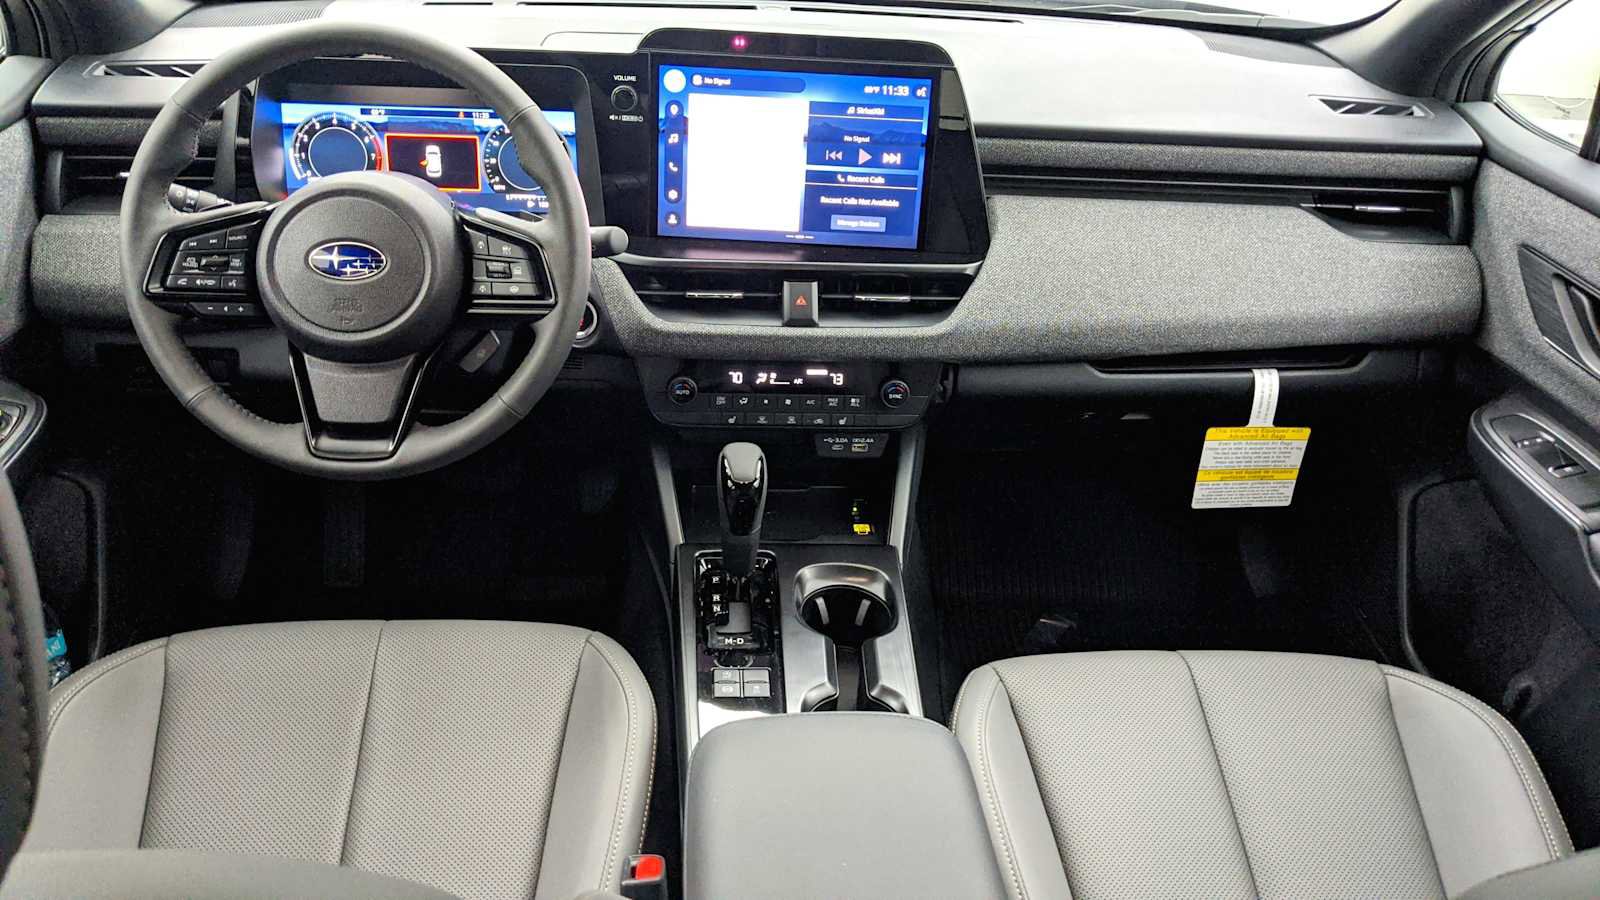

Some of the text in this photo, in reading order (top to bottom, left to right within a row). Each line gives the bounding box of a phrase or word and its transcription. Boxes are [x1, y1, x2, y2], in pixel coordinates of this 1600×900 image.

[714, 77, 731, 86] Signal
[882, 85, 910, 96] 11:33
[853, 136, 870, 144] Signal
[847, 175, 885, 184] Recent Calls
[820, 196, 900, 208] Recent Calls Not Available
[728, 371, 743, 384] 70
[829, 373, 844, 386] 73
[712, 604, 721, 612] N
